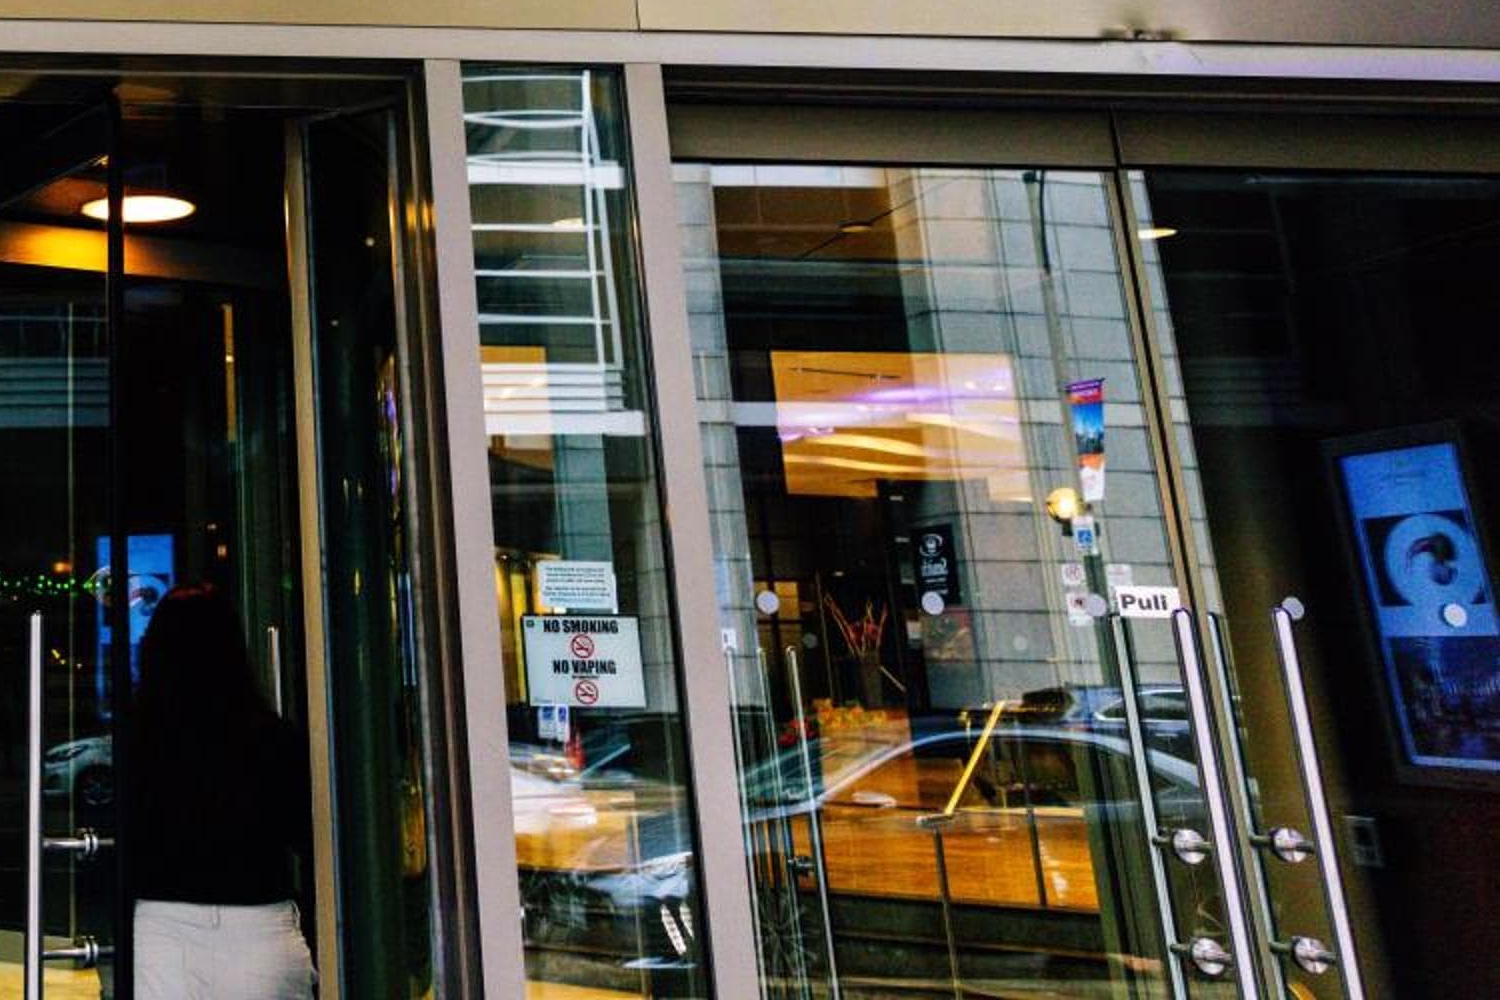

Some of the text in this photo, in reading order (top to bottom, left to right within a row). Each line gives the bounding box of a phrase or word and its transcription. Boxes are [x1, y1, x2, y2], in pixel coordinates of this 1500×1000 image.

[543, 620, 619, 634] NO SMOKING
[553, 660, 617, 675] NO VAPING
